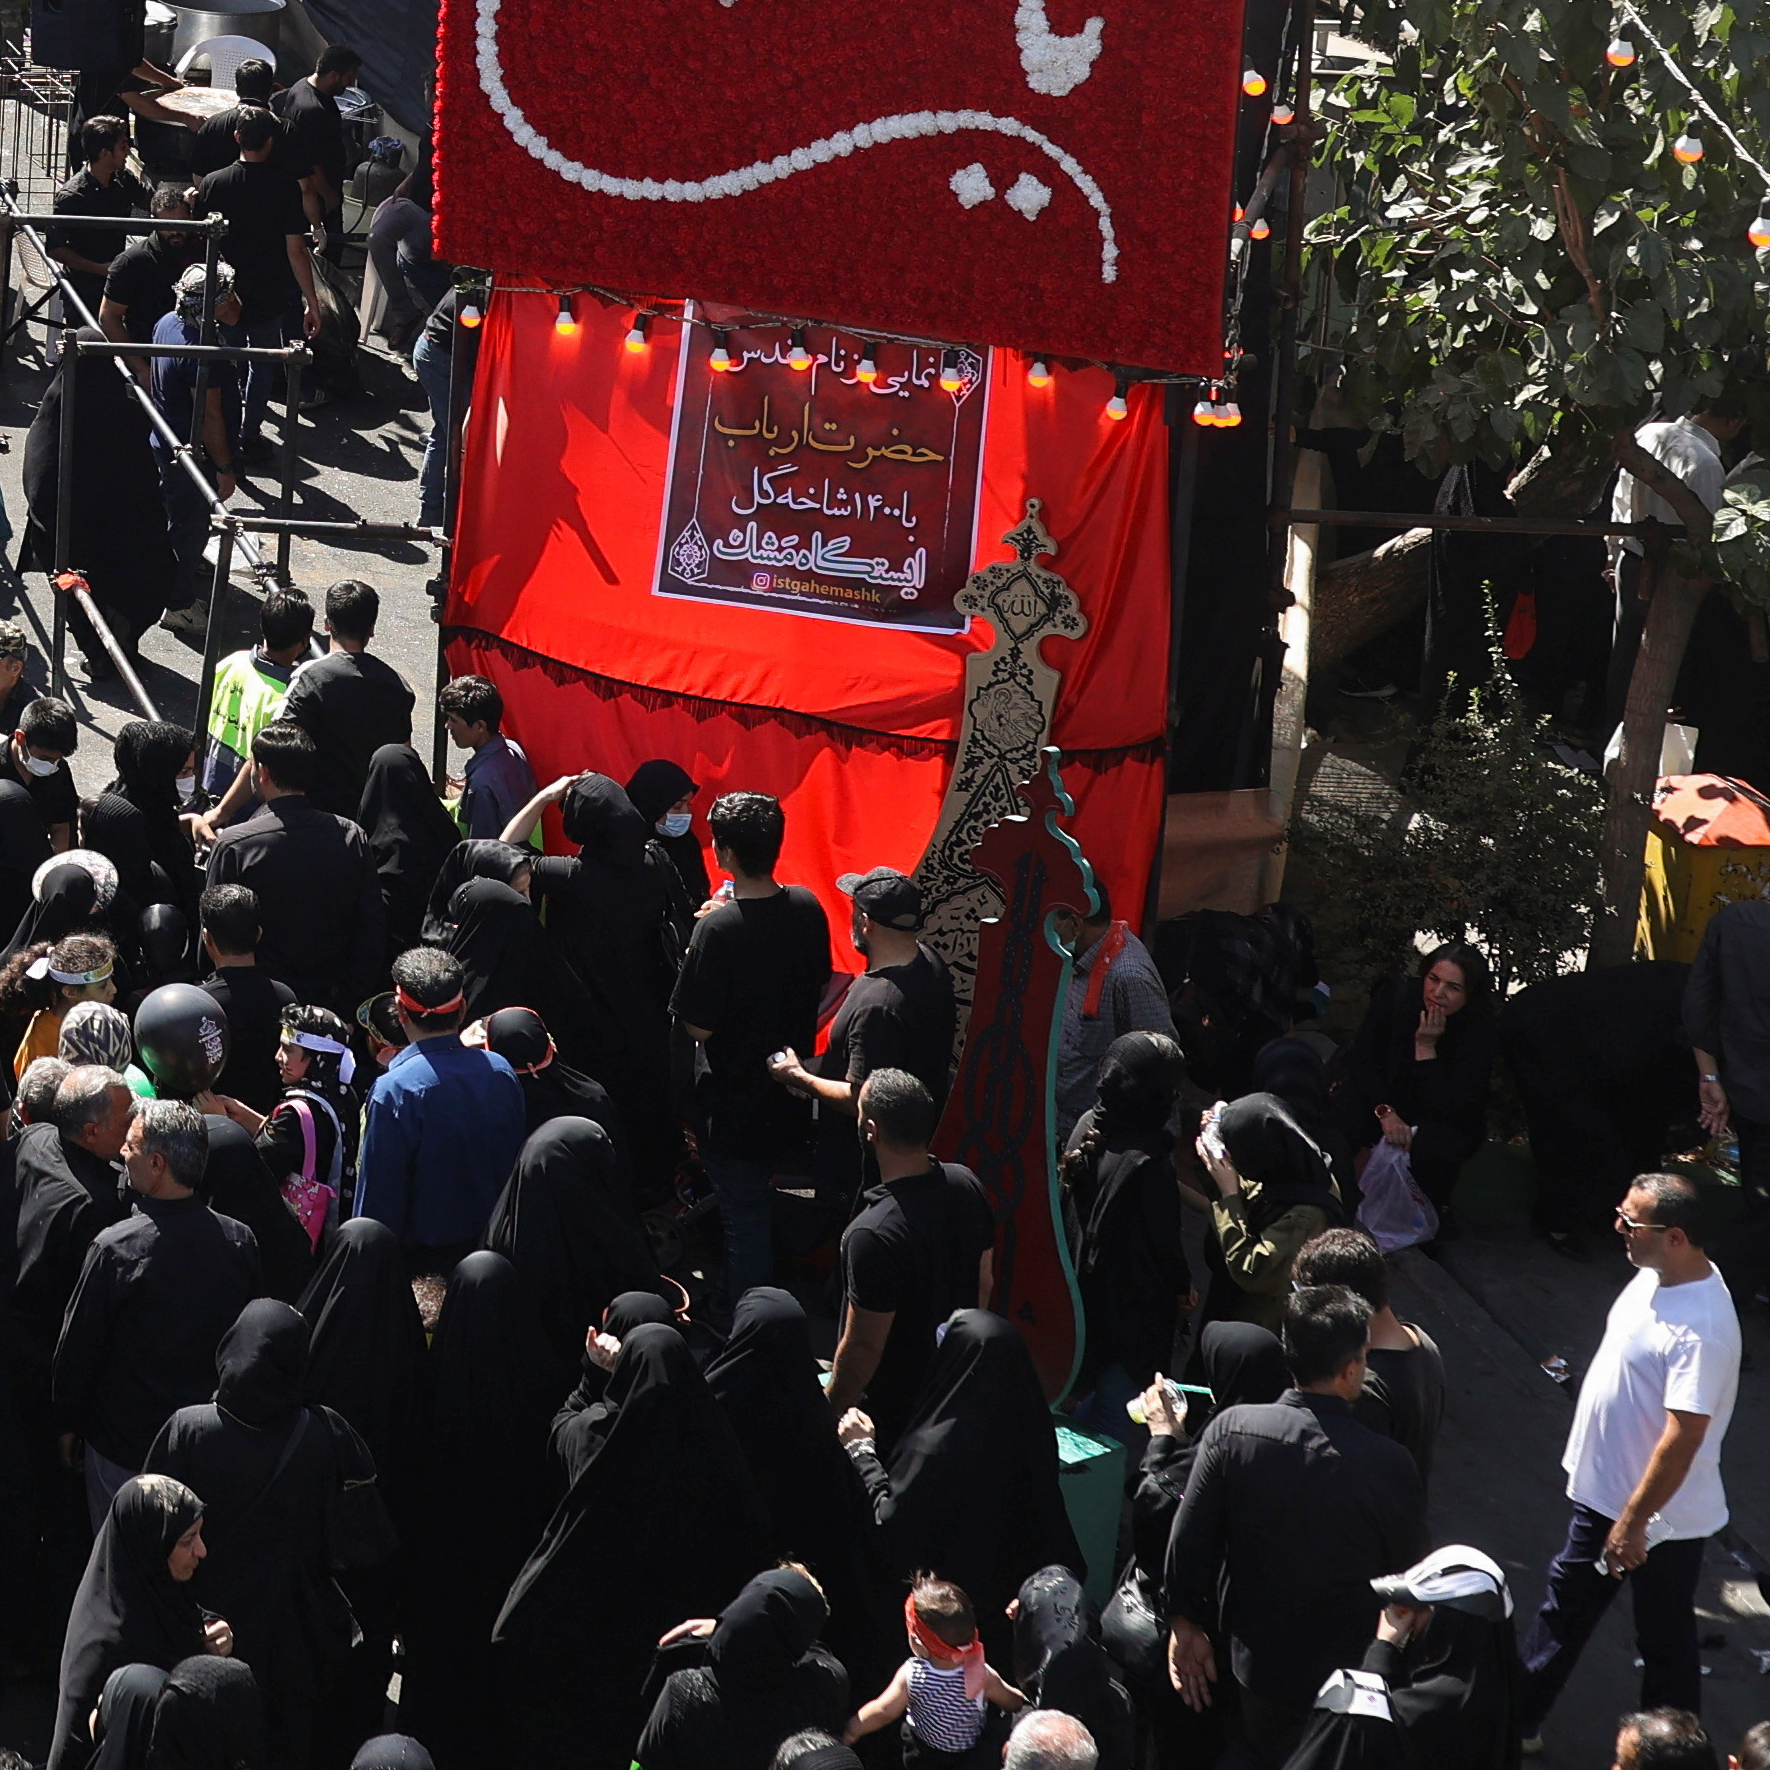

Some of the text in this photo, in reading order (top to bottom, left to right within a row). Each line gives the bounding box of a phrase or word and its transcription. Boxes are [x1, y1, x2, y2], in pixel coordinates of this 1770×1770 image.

[808, 420, 945, 469] حضرت
[730, 463, 919, 543] با ۱۴۰۰ شاخه گل
[772, 574, 882, 604] istgahemashk
[795, 530, 927, 600] ایستگاه
